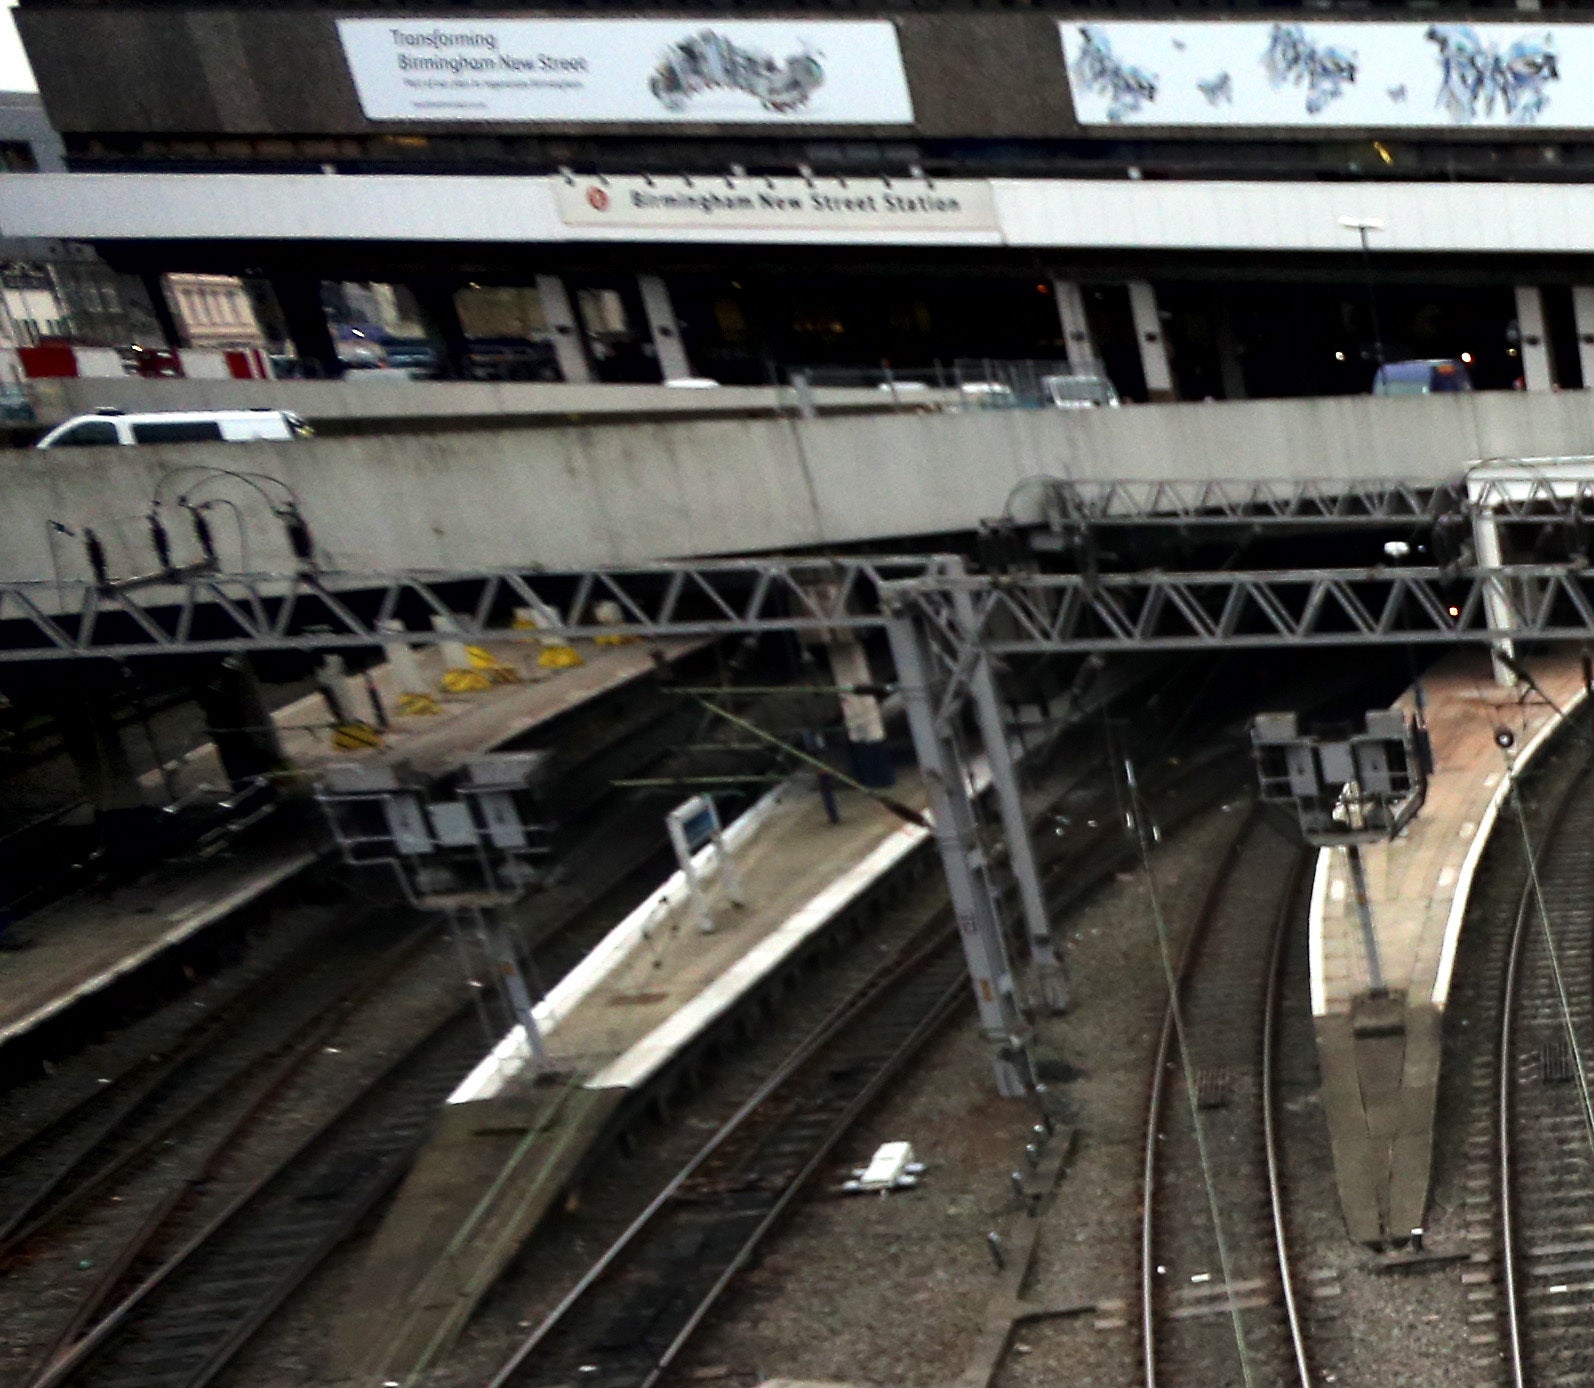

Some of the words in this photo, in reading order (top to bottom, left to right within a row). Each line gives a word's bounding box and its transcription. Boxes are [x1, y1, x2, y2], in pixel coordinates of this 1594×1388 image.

[389, 29, 498, 49] Transforming
[398, 53, 495, 73] Birmingham
[499, 54, 533, 71] New
[538, 54, 589, 72] Street
[630, 189, 755, 214] Birmingham
[760, 192, 802, 212] New
[812, 193, 877, 212] Street
[886, 193, 961, 212] Station
